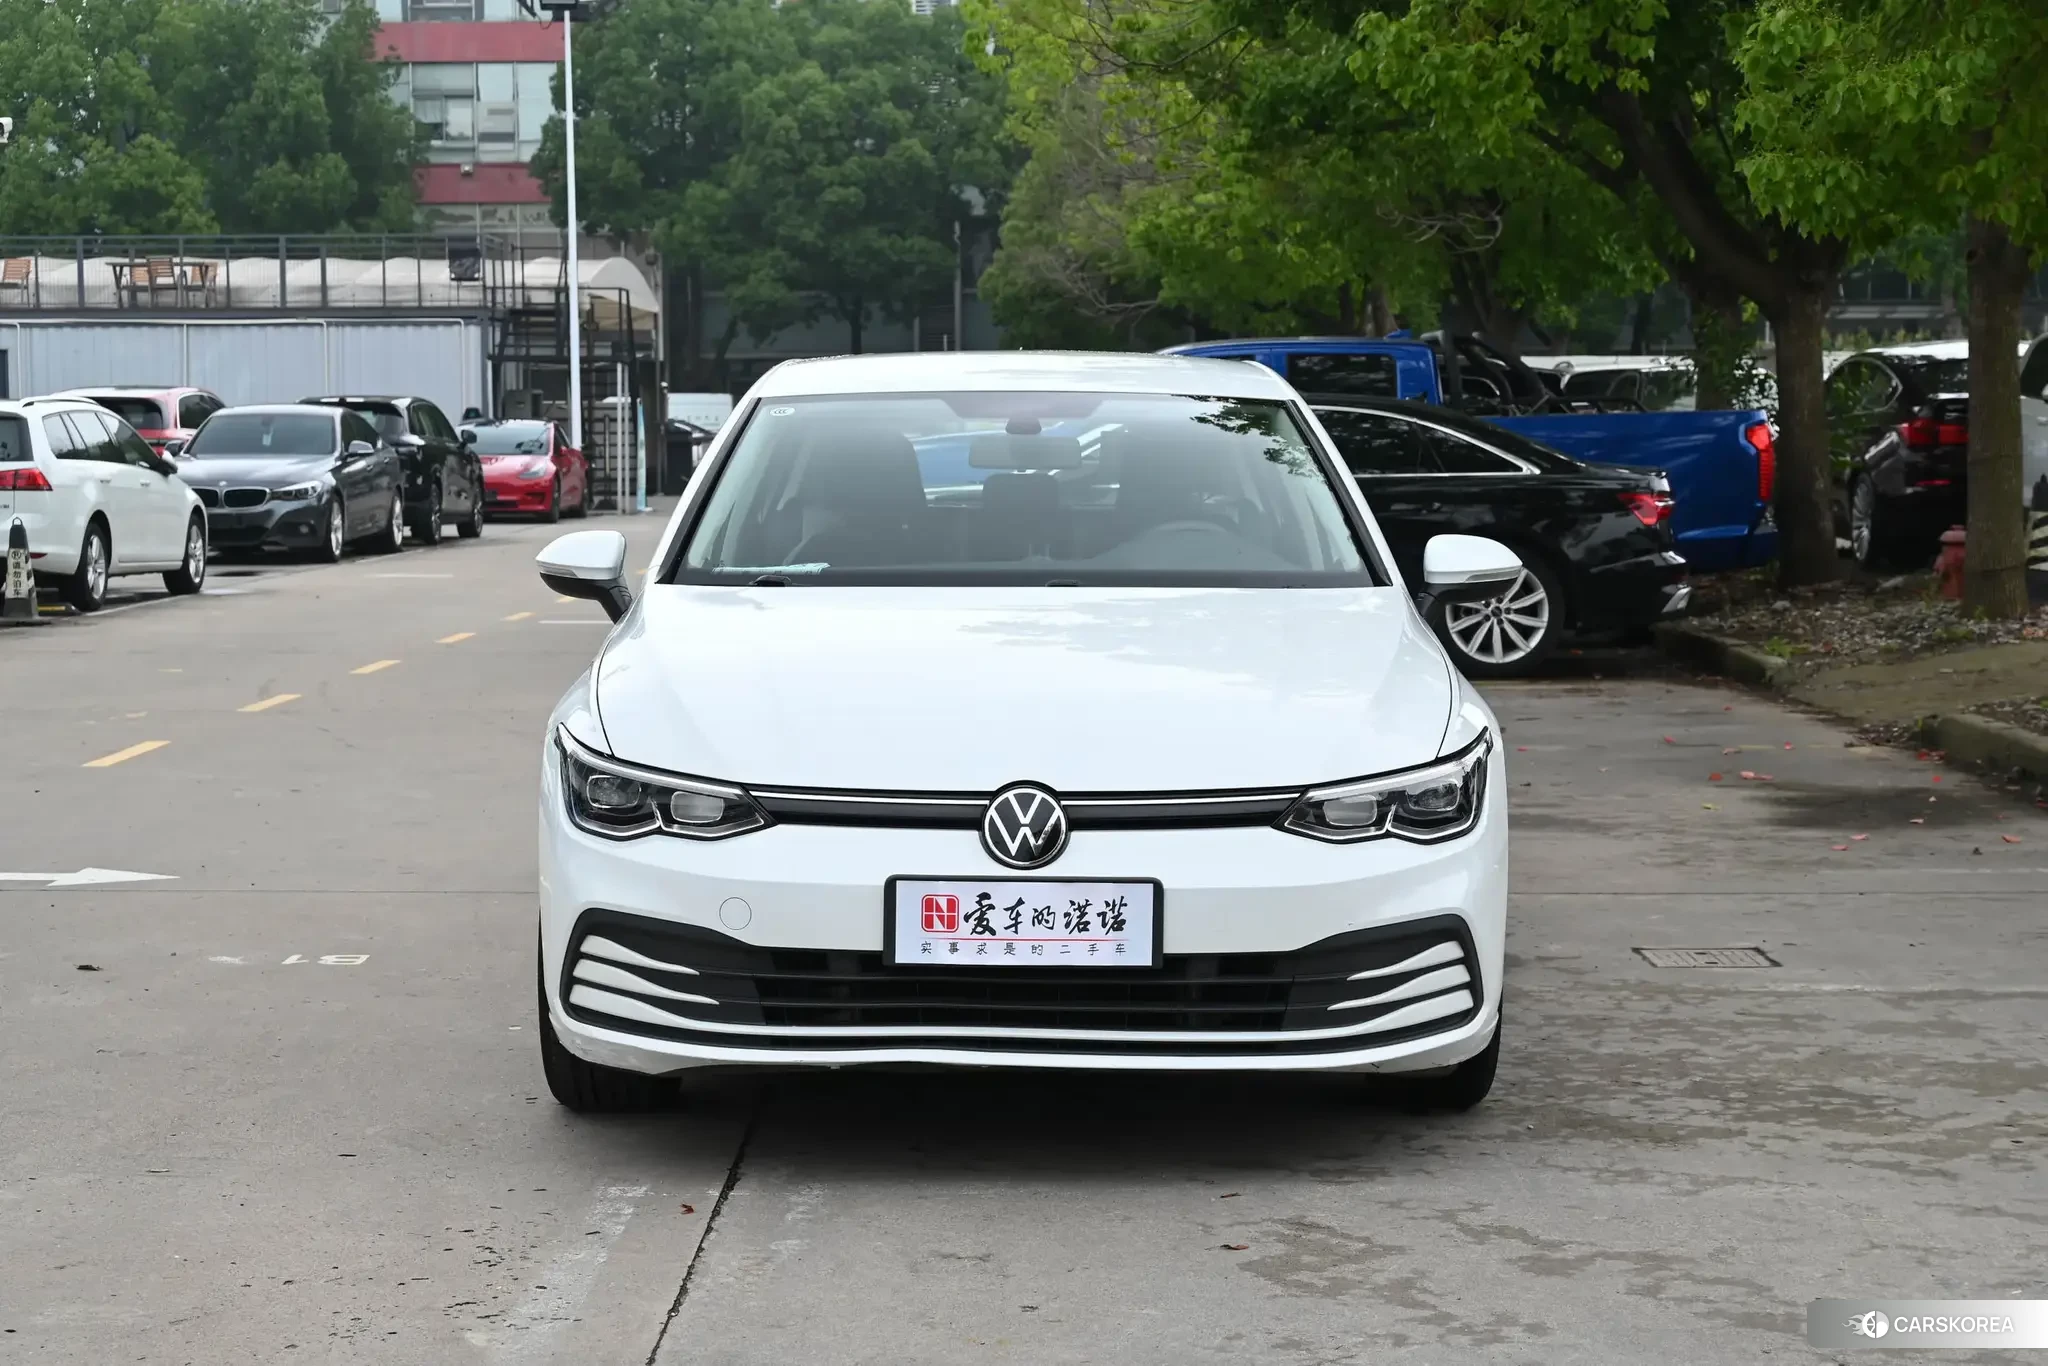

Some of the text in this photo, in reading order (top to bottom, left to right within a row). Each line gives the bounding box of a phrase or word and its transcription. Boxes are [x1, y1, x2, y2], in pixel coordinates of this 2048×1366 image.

[920, 941, 1127, 957] 实事求是的二手车
